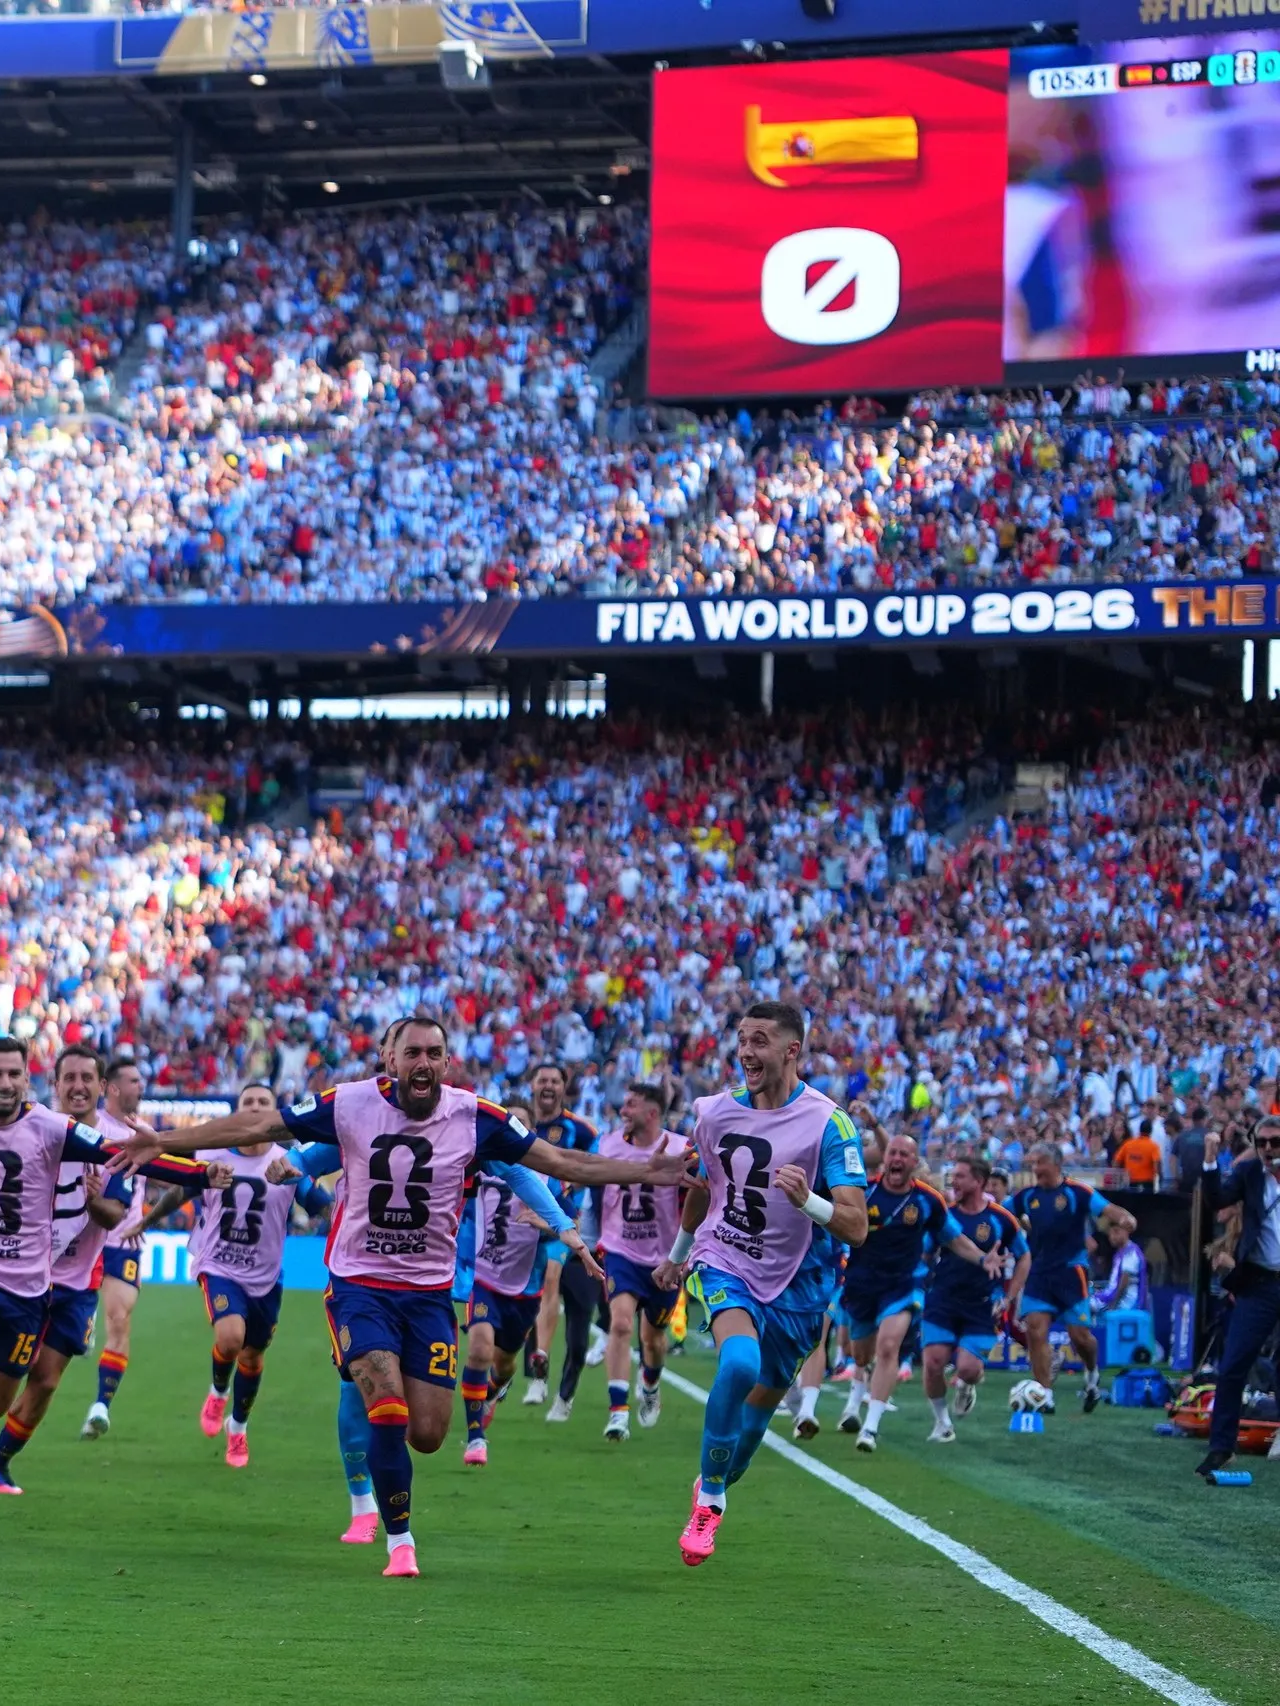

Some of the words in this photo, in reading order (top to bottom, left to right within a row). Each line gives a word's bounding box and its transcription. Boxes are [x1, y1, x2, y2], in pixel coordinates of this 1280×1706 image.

[1038, 70, 1108, 92] 105:41
[1170, 61, 1202, 82] ESP
[1215, 62, 1226, 77] 0
[1264, 58, 1275, 74] 0
[761, 226, 901, 346] 0
[596, 601, 696, 643] FIFA
[699, 597, 869, 641] WORLD
[873, 594, 967, 638] CUP
[971, 588, 1136, 634] 2026
[1152, 584, 1267, 628] THE
[383, 1211, 413, 1223] FIFA
[1, 1238, 23, 1248] CUP
[365, 1240, 428, 1255] 2026
[366, 1230, 405, 1242] WORLD
[407, 1232, 429, 1242] CUP
[123, 1259, 138, 1281] 8
[8, 1332, 38, 1366] 15
[429, 1342, 457, 1380] 26
